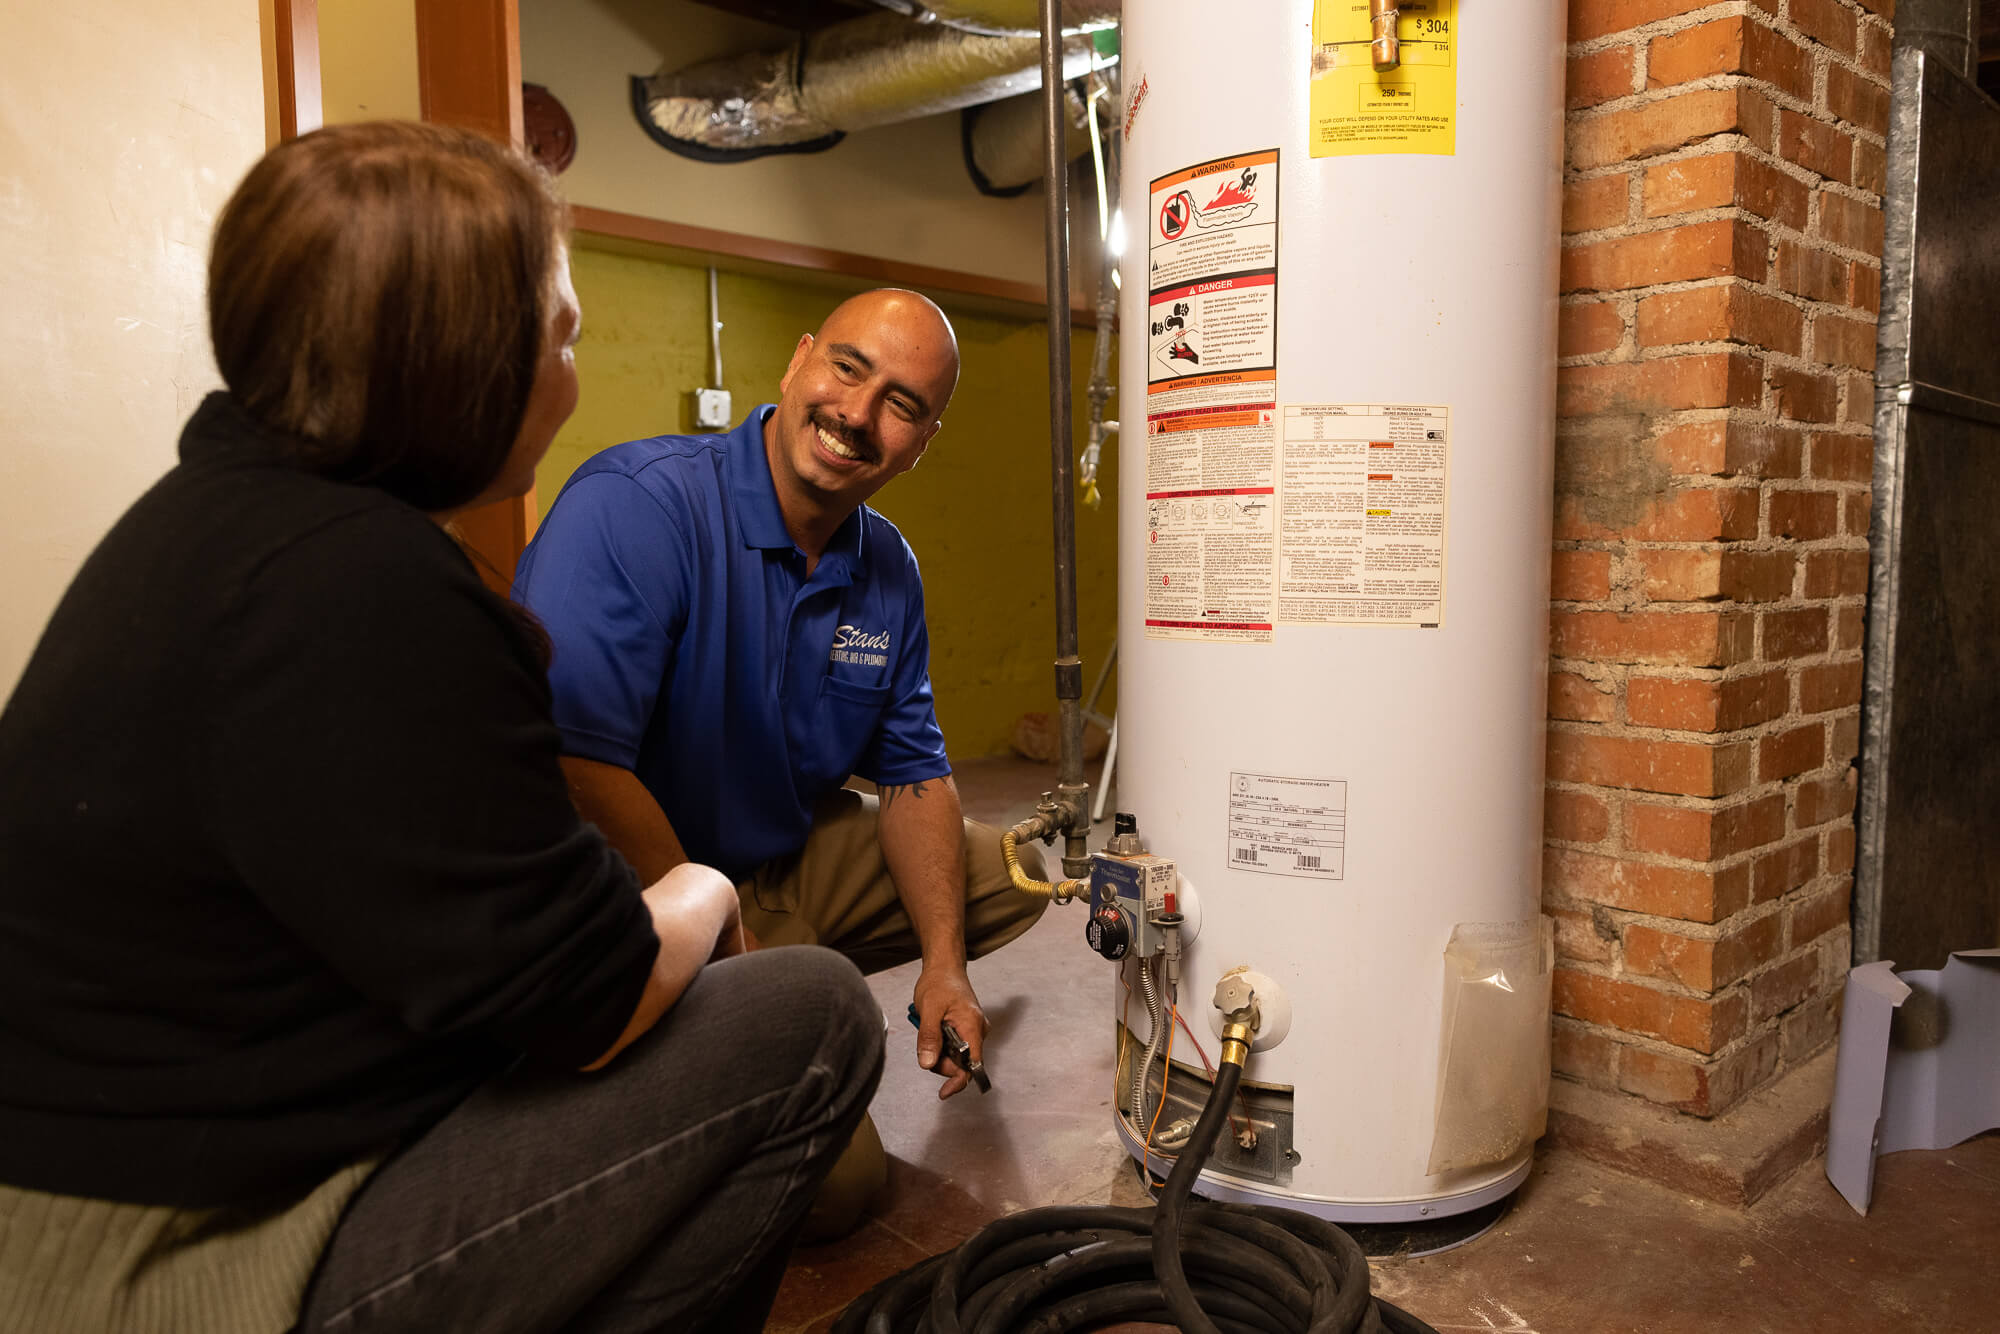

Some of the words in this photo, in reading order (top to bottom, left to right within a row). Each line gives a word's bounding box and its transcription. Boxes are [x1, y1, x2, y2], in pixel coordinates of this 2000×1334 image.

[1416, 18, 1422, 29] $
[1426, 19, 1449, 34] 304
[1382, 89, 1396, 97] 250
[1197, 161, 1235, 176] WARNING
[1198, 280, 1233, 293] DANGER
[1200, 374, 1242, 385] ADVERTENCIA
[832, 625, 890, 650] Stan's
